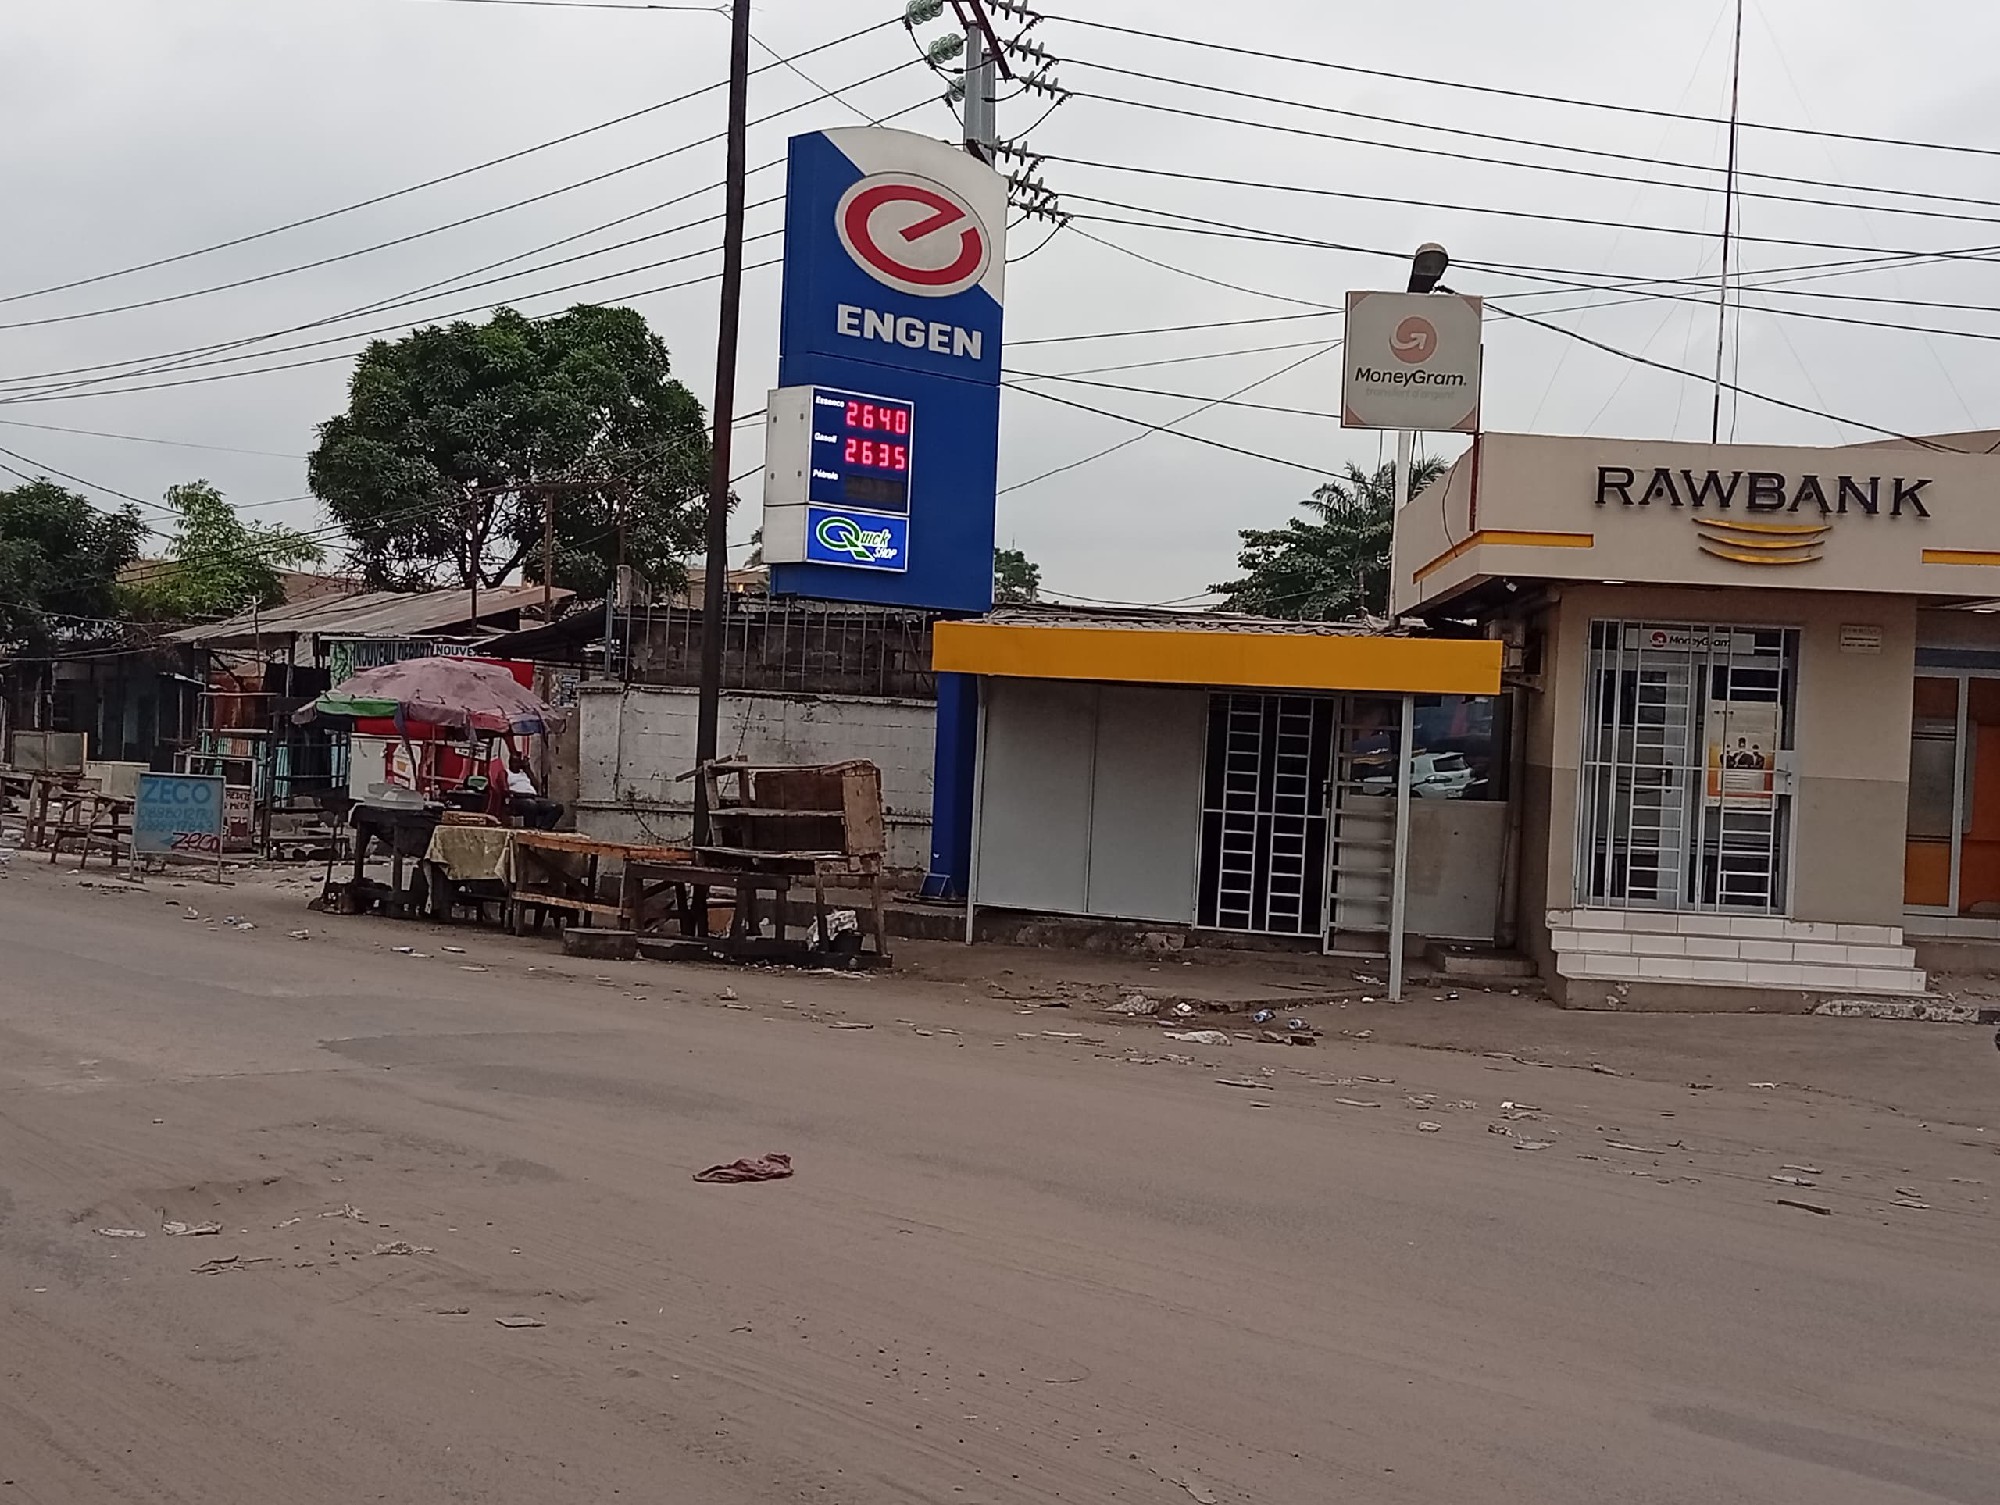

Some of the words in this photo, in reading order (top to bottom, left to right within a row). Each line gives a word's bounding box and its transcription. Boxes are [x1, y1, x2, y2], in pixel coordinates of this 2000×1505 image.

[836, 303, 983, 360] ENGEN
[845, 401, 907, 434] 2640
[844, 438, 906, 471] 2635
[1594, 466, 1934, 518] RAWBANK
[433, 643, 476, 657] NOUVE
[1668, 635, 1731, 648] MoneyGam
[141, 779, 212, 805] ZECO
